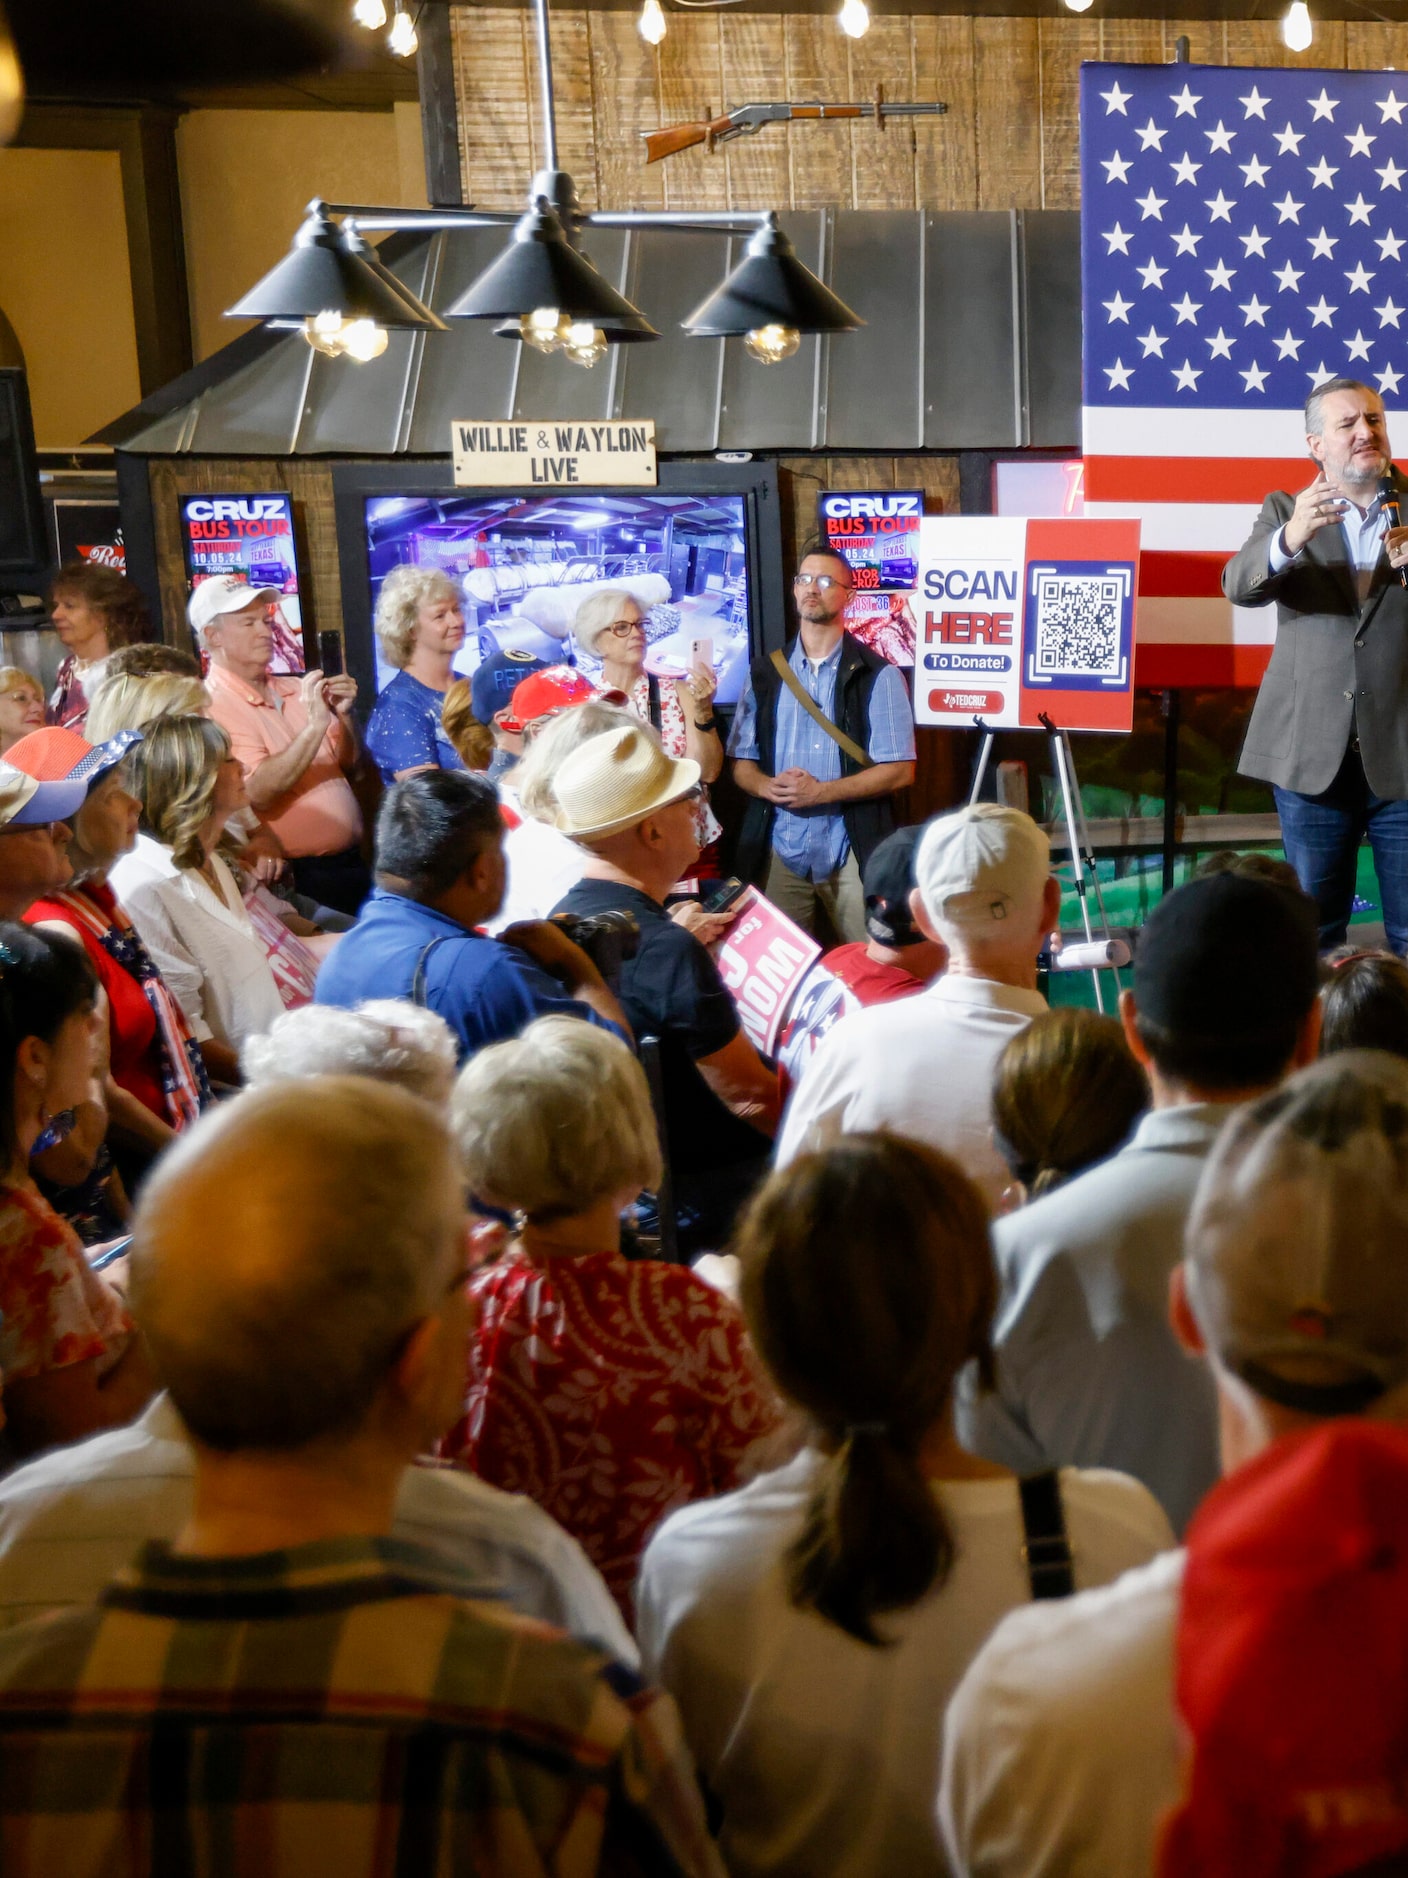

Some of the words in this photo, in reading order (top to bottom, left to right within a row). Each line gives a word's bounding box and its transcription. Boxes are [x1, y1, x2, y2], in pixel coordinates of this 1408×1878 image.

[459, 427, 528, 452] WILLIE
[537, 430, 550, 449] &
[555, 427, 647, 452] WAYLON
[531, 458, 579, 482] LIVE
[187, 500, 286, 521] CRUZ
[825, 497, 918, 518] CRUZ
[190, 521, 230, 539] BUS
[233, 520, 292, 537] TOUR
[827, 518, 865, 534] BUS
[193, 542, 242, 554] SATURDAY
[830, 538, 875, 549] SATURDAY
[883, 544, 905, 557] TEXAS
[194, 553, 242, 563] 10.05.24
[251, 548, 274, 561] TEXAS
[924, 569, 1017, 600] SCAN
[877, 596, 889, 610] 36
[925, 611, 1014, 645] HERE
[931, 655, 948, 668] To
[951, 655, 1005, 669] Donate!
[494, 668, 525, 690] PET
[734, 916, 764, 944] for
[736, 937, 805, 1051] WOM
